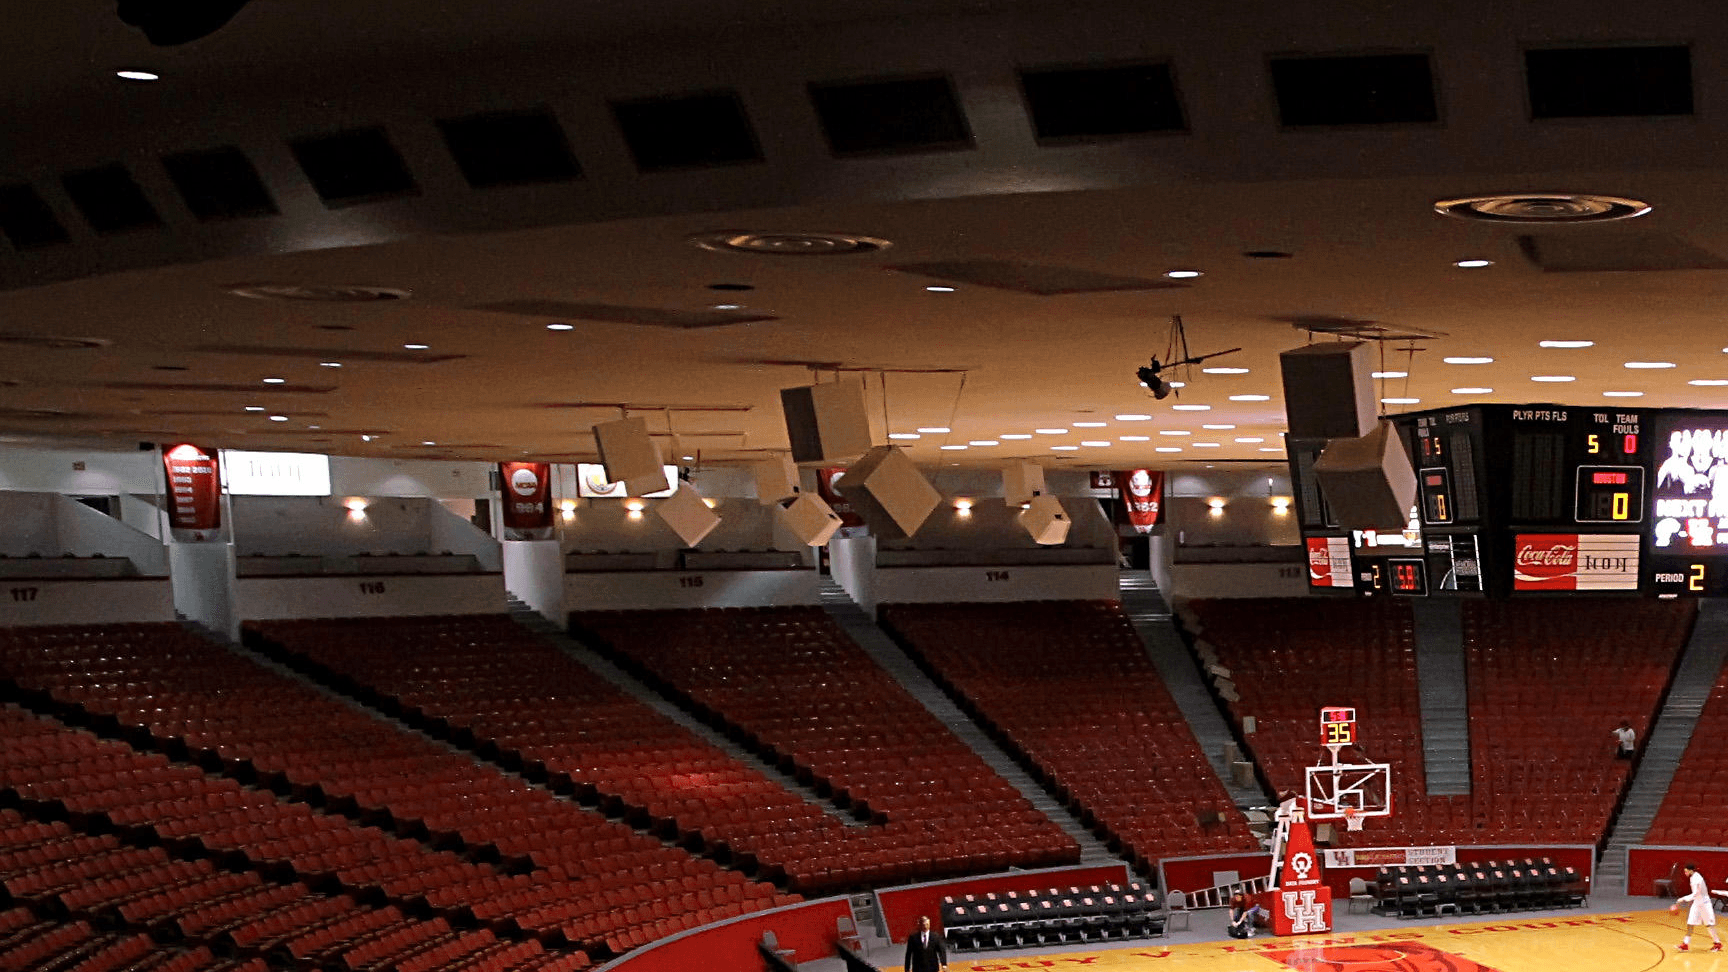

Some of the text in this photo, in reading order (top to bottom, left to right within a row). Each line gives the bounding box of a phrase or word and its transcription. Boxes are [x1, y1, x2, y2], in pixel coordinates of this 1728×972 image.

[1513, 410, 1567, 421] PLYR PTS FLS
[1593, 413, 1608, 423] TOL
[1616, 414, 1638, 424] TEAM
[1613, 425, 1639, 434] FOULS
[1588, 435, 1599, 453] 5
[1624, 435, 1636, 453] 0
[1613, 493, 1629, 520] 0
[1517, 545, 1576, 566] Coca-Cola
[1655, 573, 1684, 582] PERIOD
[1690, 564, 1704, 590] 2
[10, 587, 38, 601] 117
[1328, 723, 1350, 742] 35
[1282, 890, 1326, 933] UH
[1449, 916, 1634, 935] COURT
